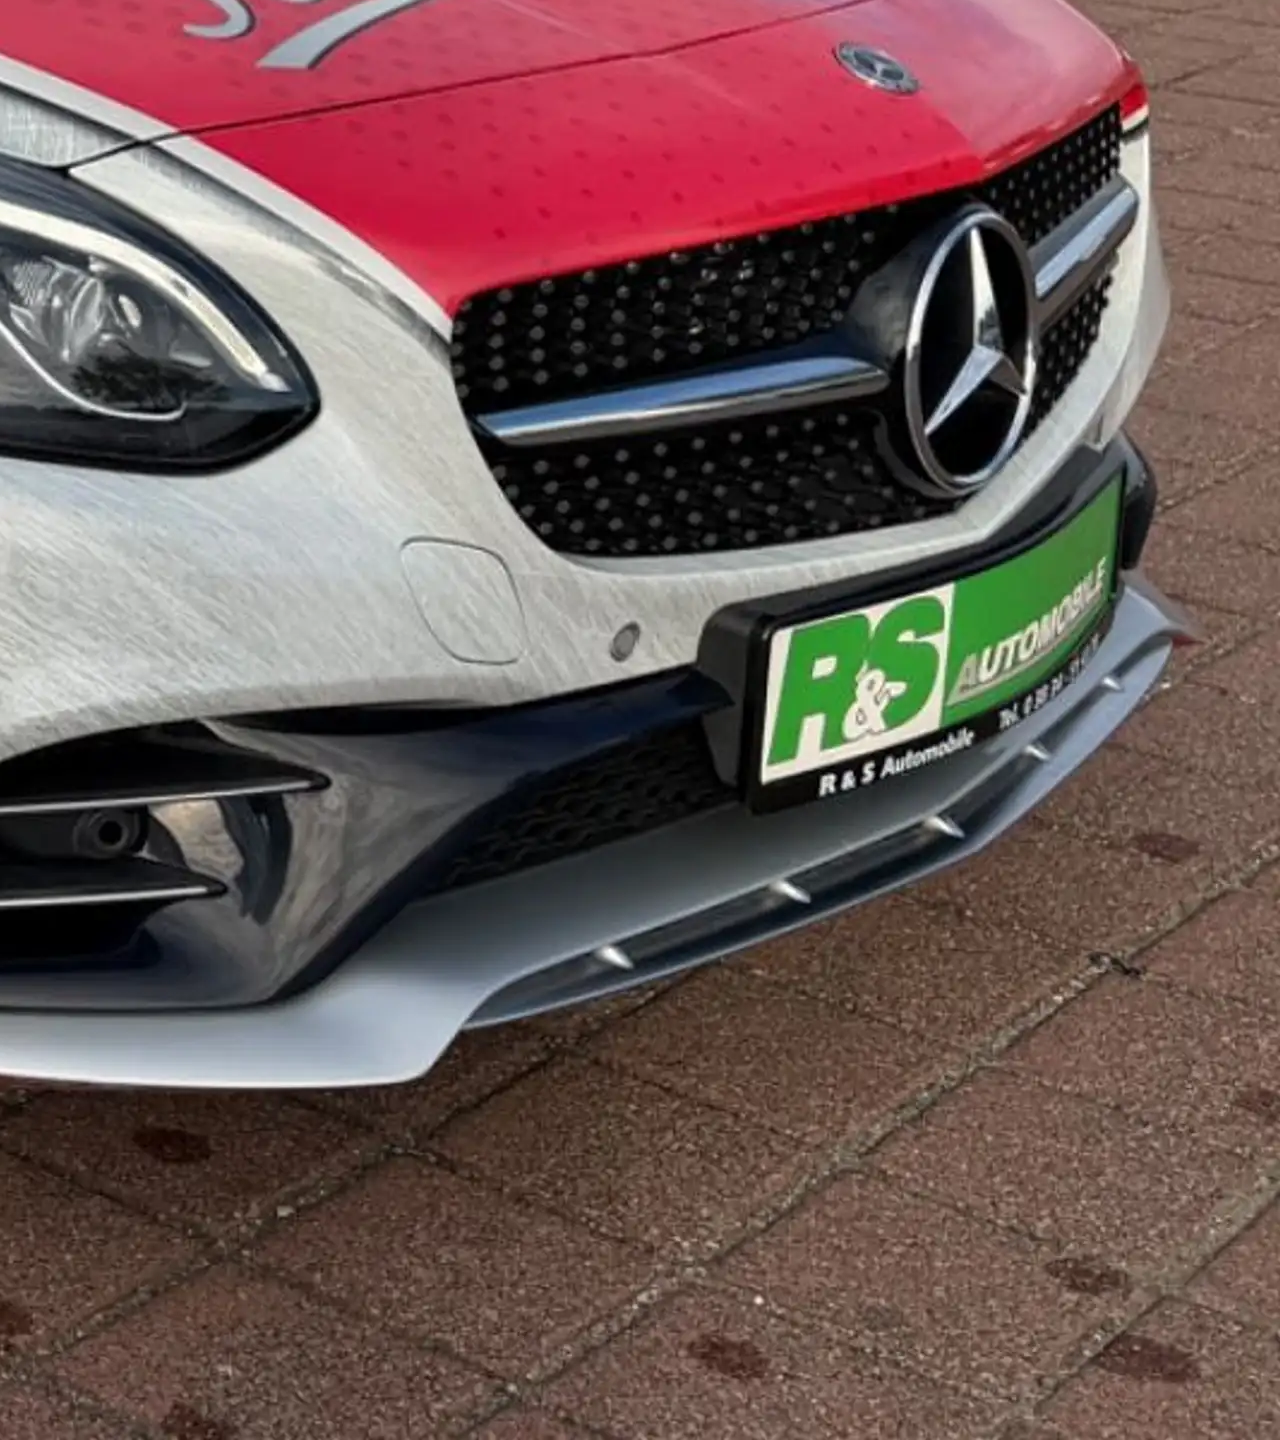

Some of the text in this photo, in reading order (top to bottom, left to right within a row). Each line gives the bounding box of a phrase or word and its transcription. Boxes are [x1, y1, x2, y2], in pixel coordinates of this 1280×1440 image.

[767, 594, 945, 766] R&S
[957, 556, 1107, 695] AUTOMOBILE
[818, 773, 837, 797] R
[841, 772, 856, 791] &
[861, 761, 876, 785] S
[880, 727, 975, 778] Automobile
